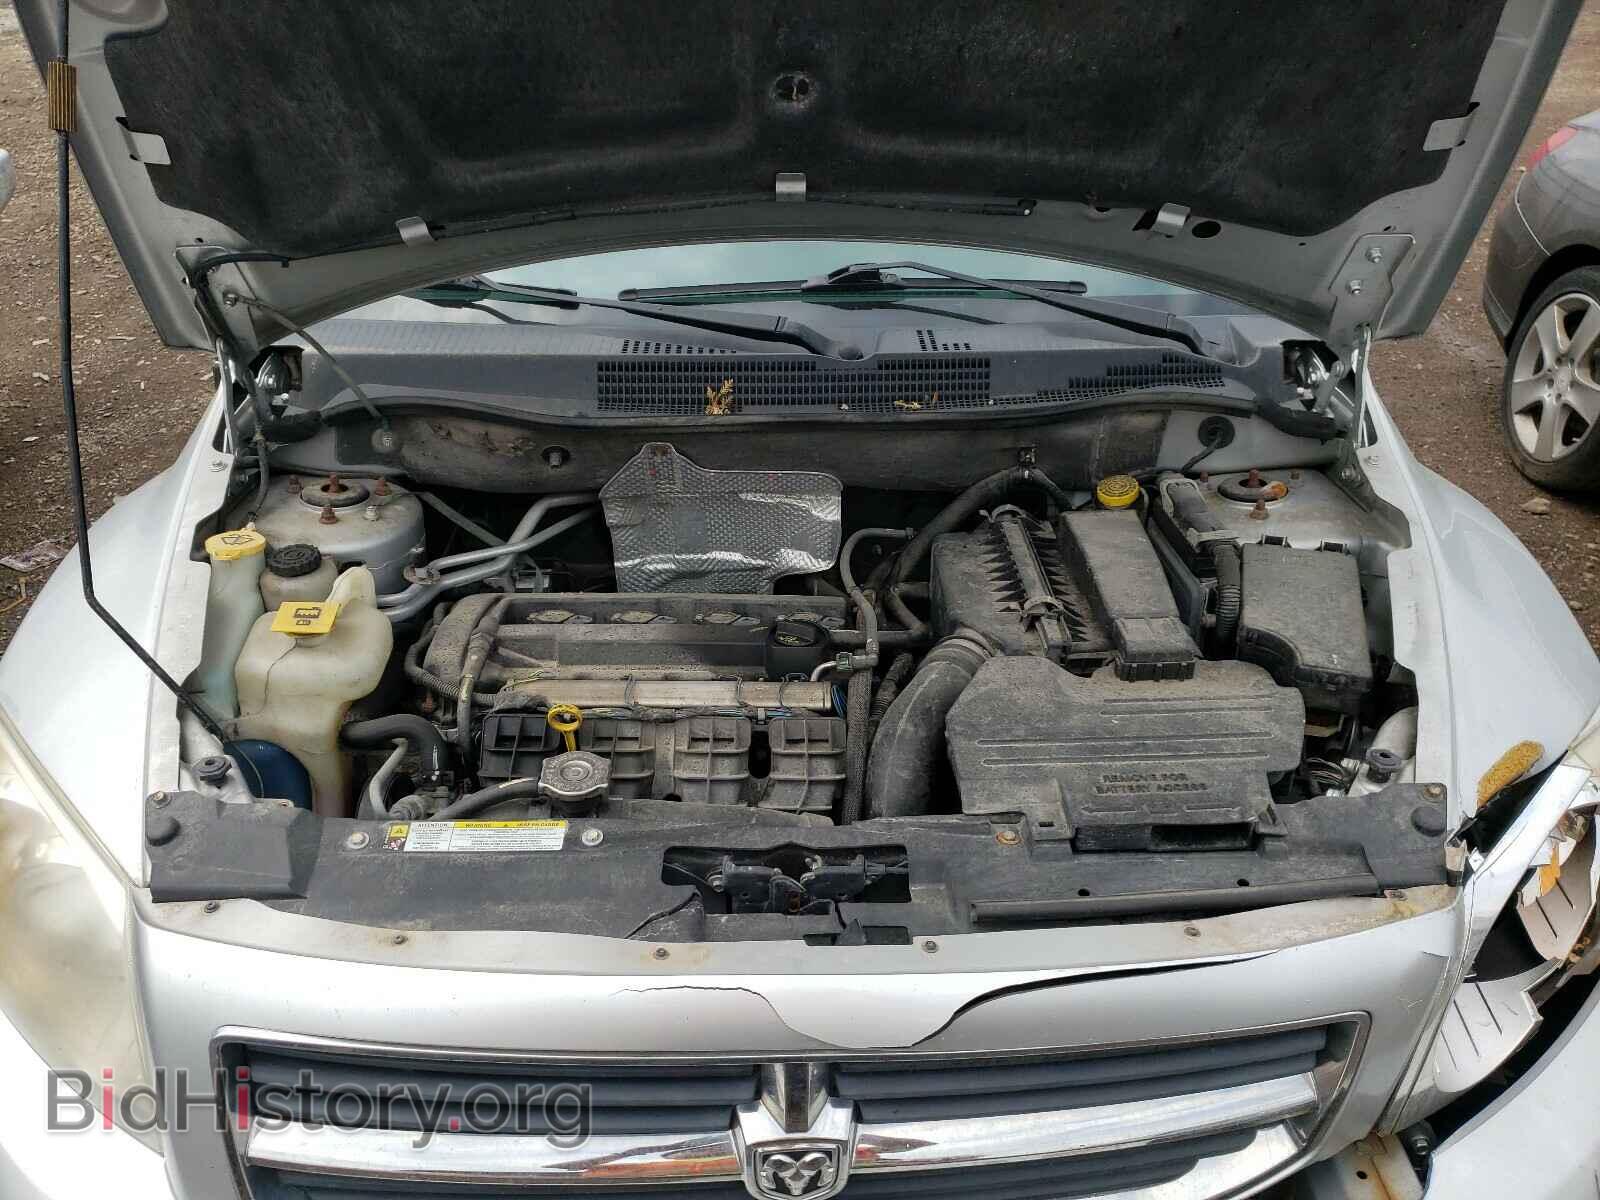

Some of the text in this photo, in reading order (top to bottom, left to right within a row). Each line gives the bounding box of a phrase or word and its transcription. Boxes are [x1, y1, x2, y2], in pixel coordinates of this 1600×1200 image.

[1103, 773, 1188, 783] REMOVE FOR
[1096, 783, 1208, 795] BATTERY ACCESS
